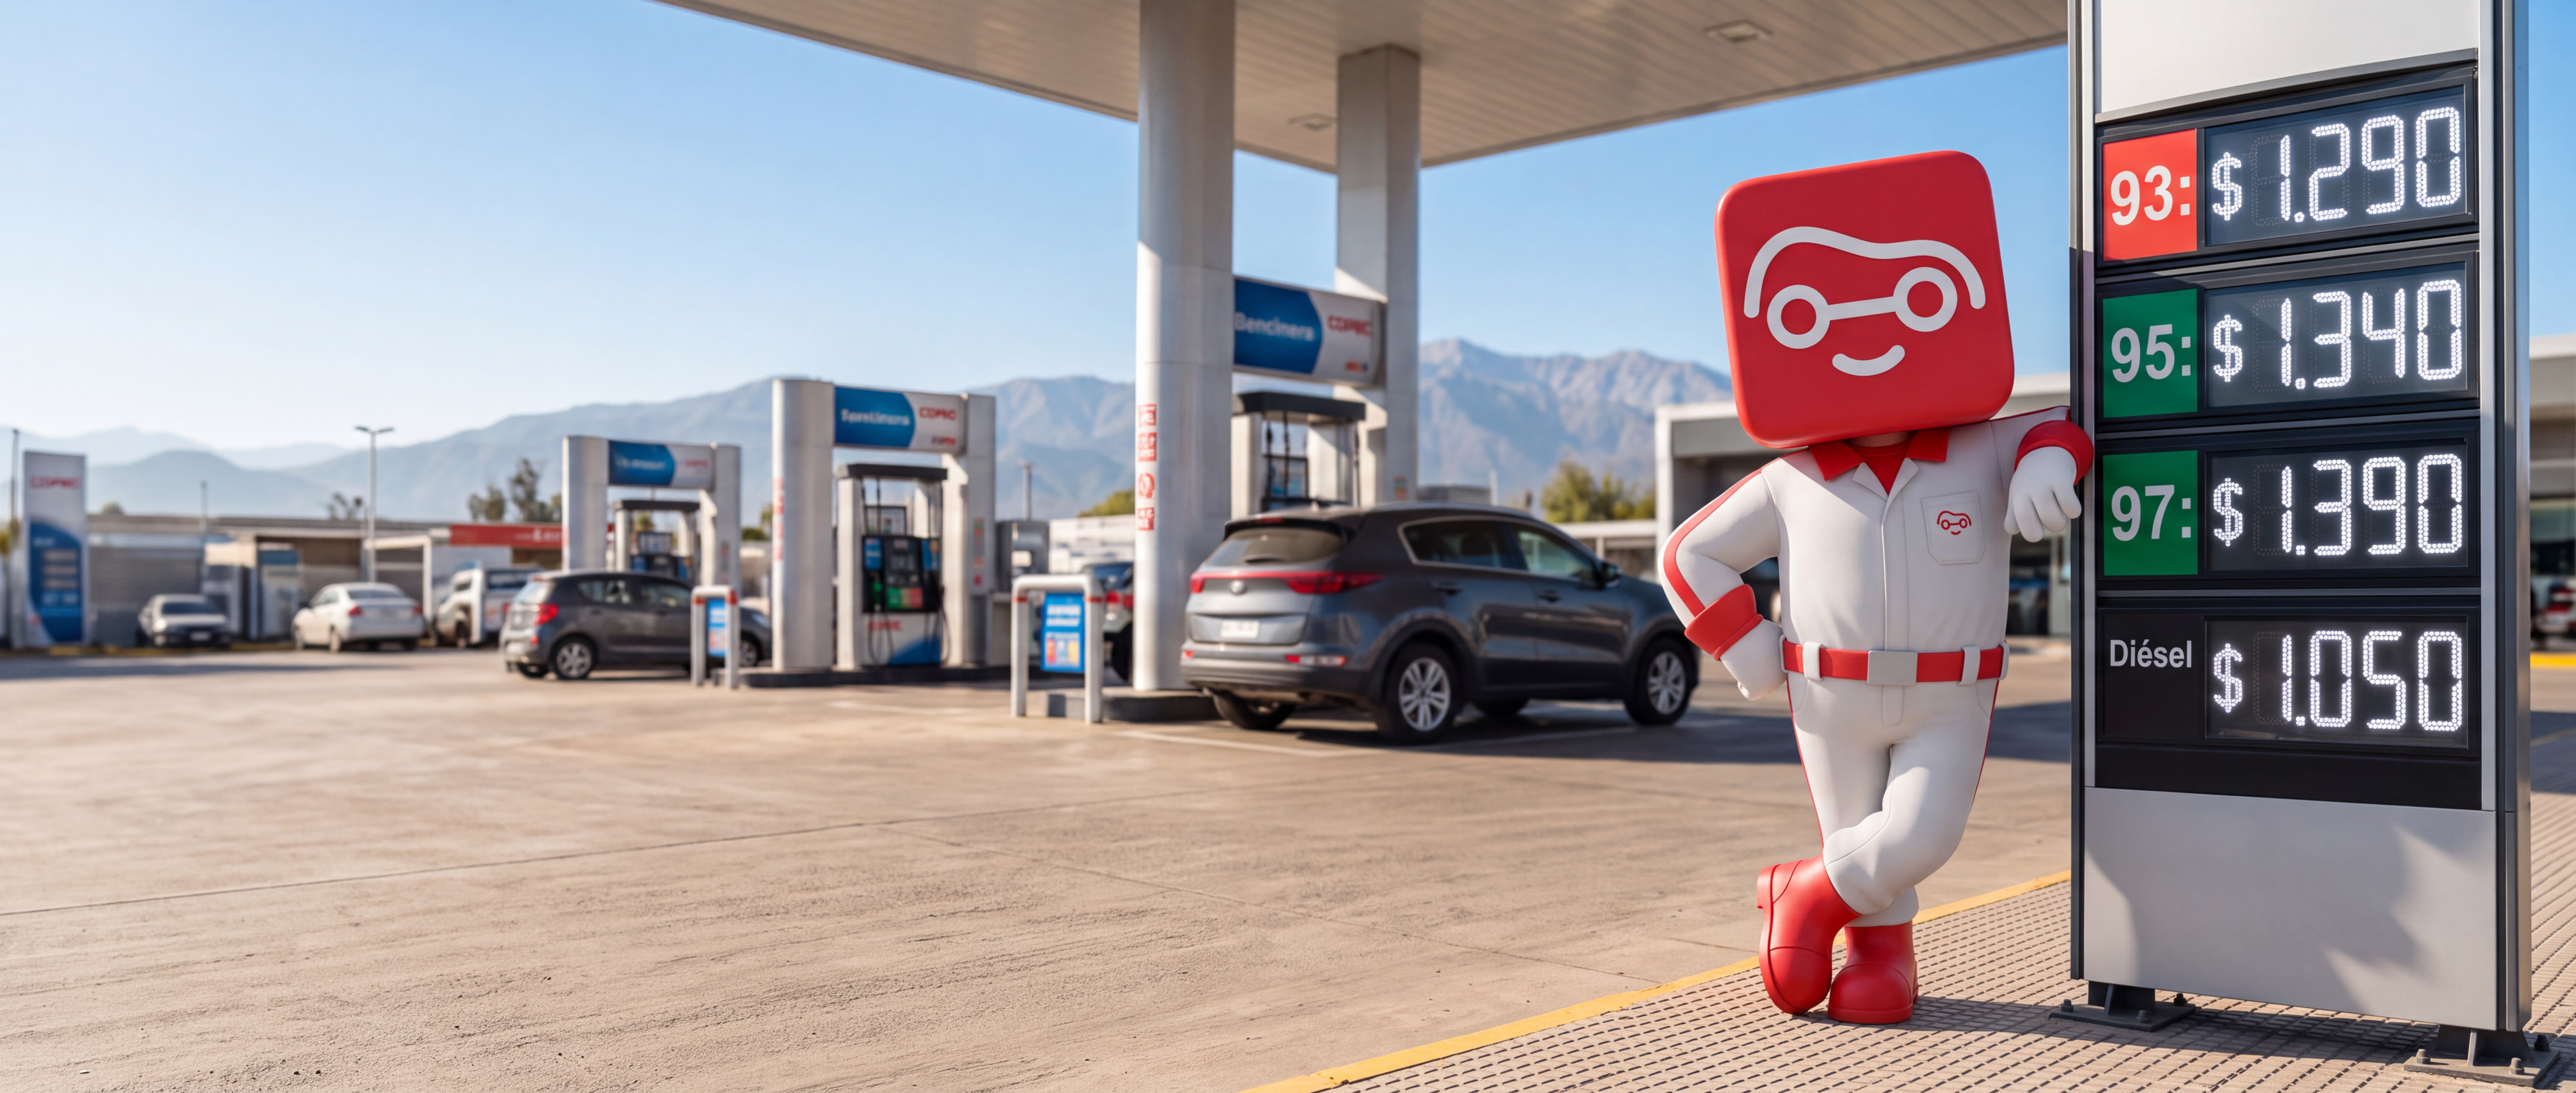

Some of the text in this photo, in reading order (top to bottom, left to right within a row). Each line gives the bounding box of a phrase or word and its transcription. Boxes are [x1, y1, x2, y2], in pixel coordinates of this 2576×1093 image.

[2110, 106, 2462, 226] 93: $ 1.290
[2110, 279, 2463, 390] 95: $ 1.340
[2111, 453, 2463, 556] 97: $ 1.390
[2109, 630, 2463, 732] Diésel $ 1.050
